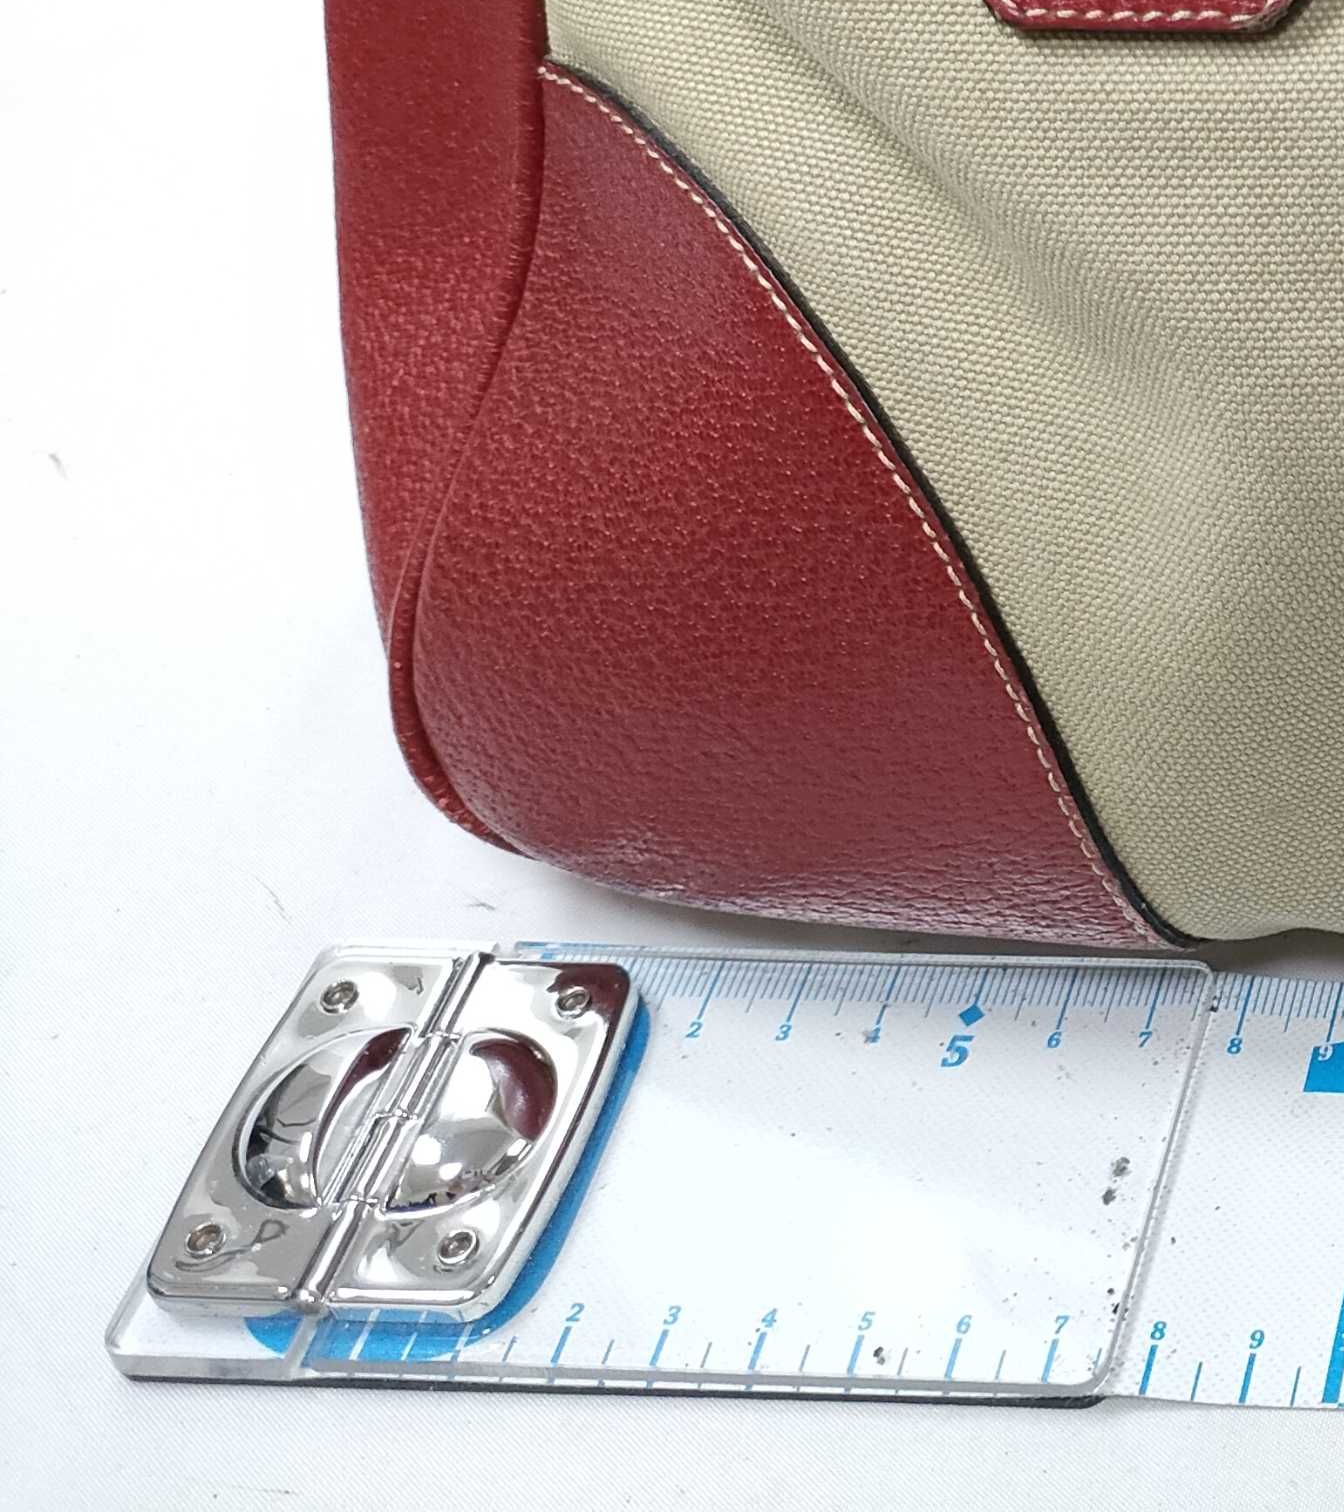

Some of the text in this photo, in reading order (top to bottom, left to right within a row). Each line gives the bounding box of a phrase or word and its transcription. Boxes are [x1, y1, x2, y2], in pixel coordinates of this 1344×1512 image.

[686, 1021, 703, 1038] 2
[775, 1024, 792, 1041] 3
[941, 1035, 974, 1067] 5
[1046, 1031, 1062, 1048] 6
[1138, 1032, 1153, 1048] 7
[1227, 1037, 1244, 1054] 8
[1317, 1045, 1334, 1061] 9
[567, 1303, 585, 1322] 2
[663, 1306, 681, 1325] 3
[760, 1309, 777, 1327] 4
[858, 1312, 875, 1330] 5
[956, 1315, 972, 1334] 6
[1054, 1316, 1070, 1334] 7
[1150, 1321, 1167, 1340] 8
[1249, 1330, 1265, 1349] 9
